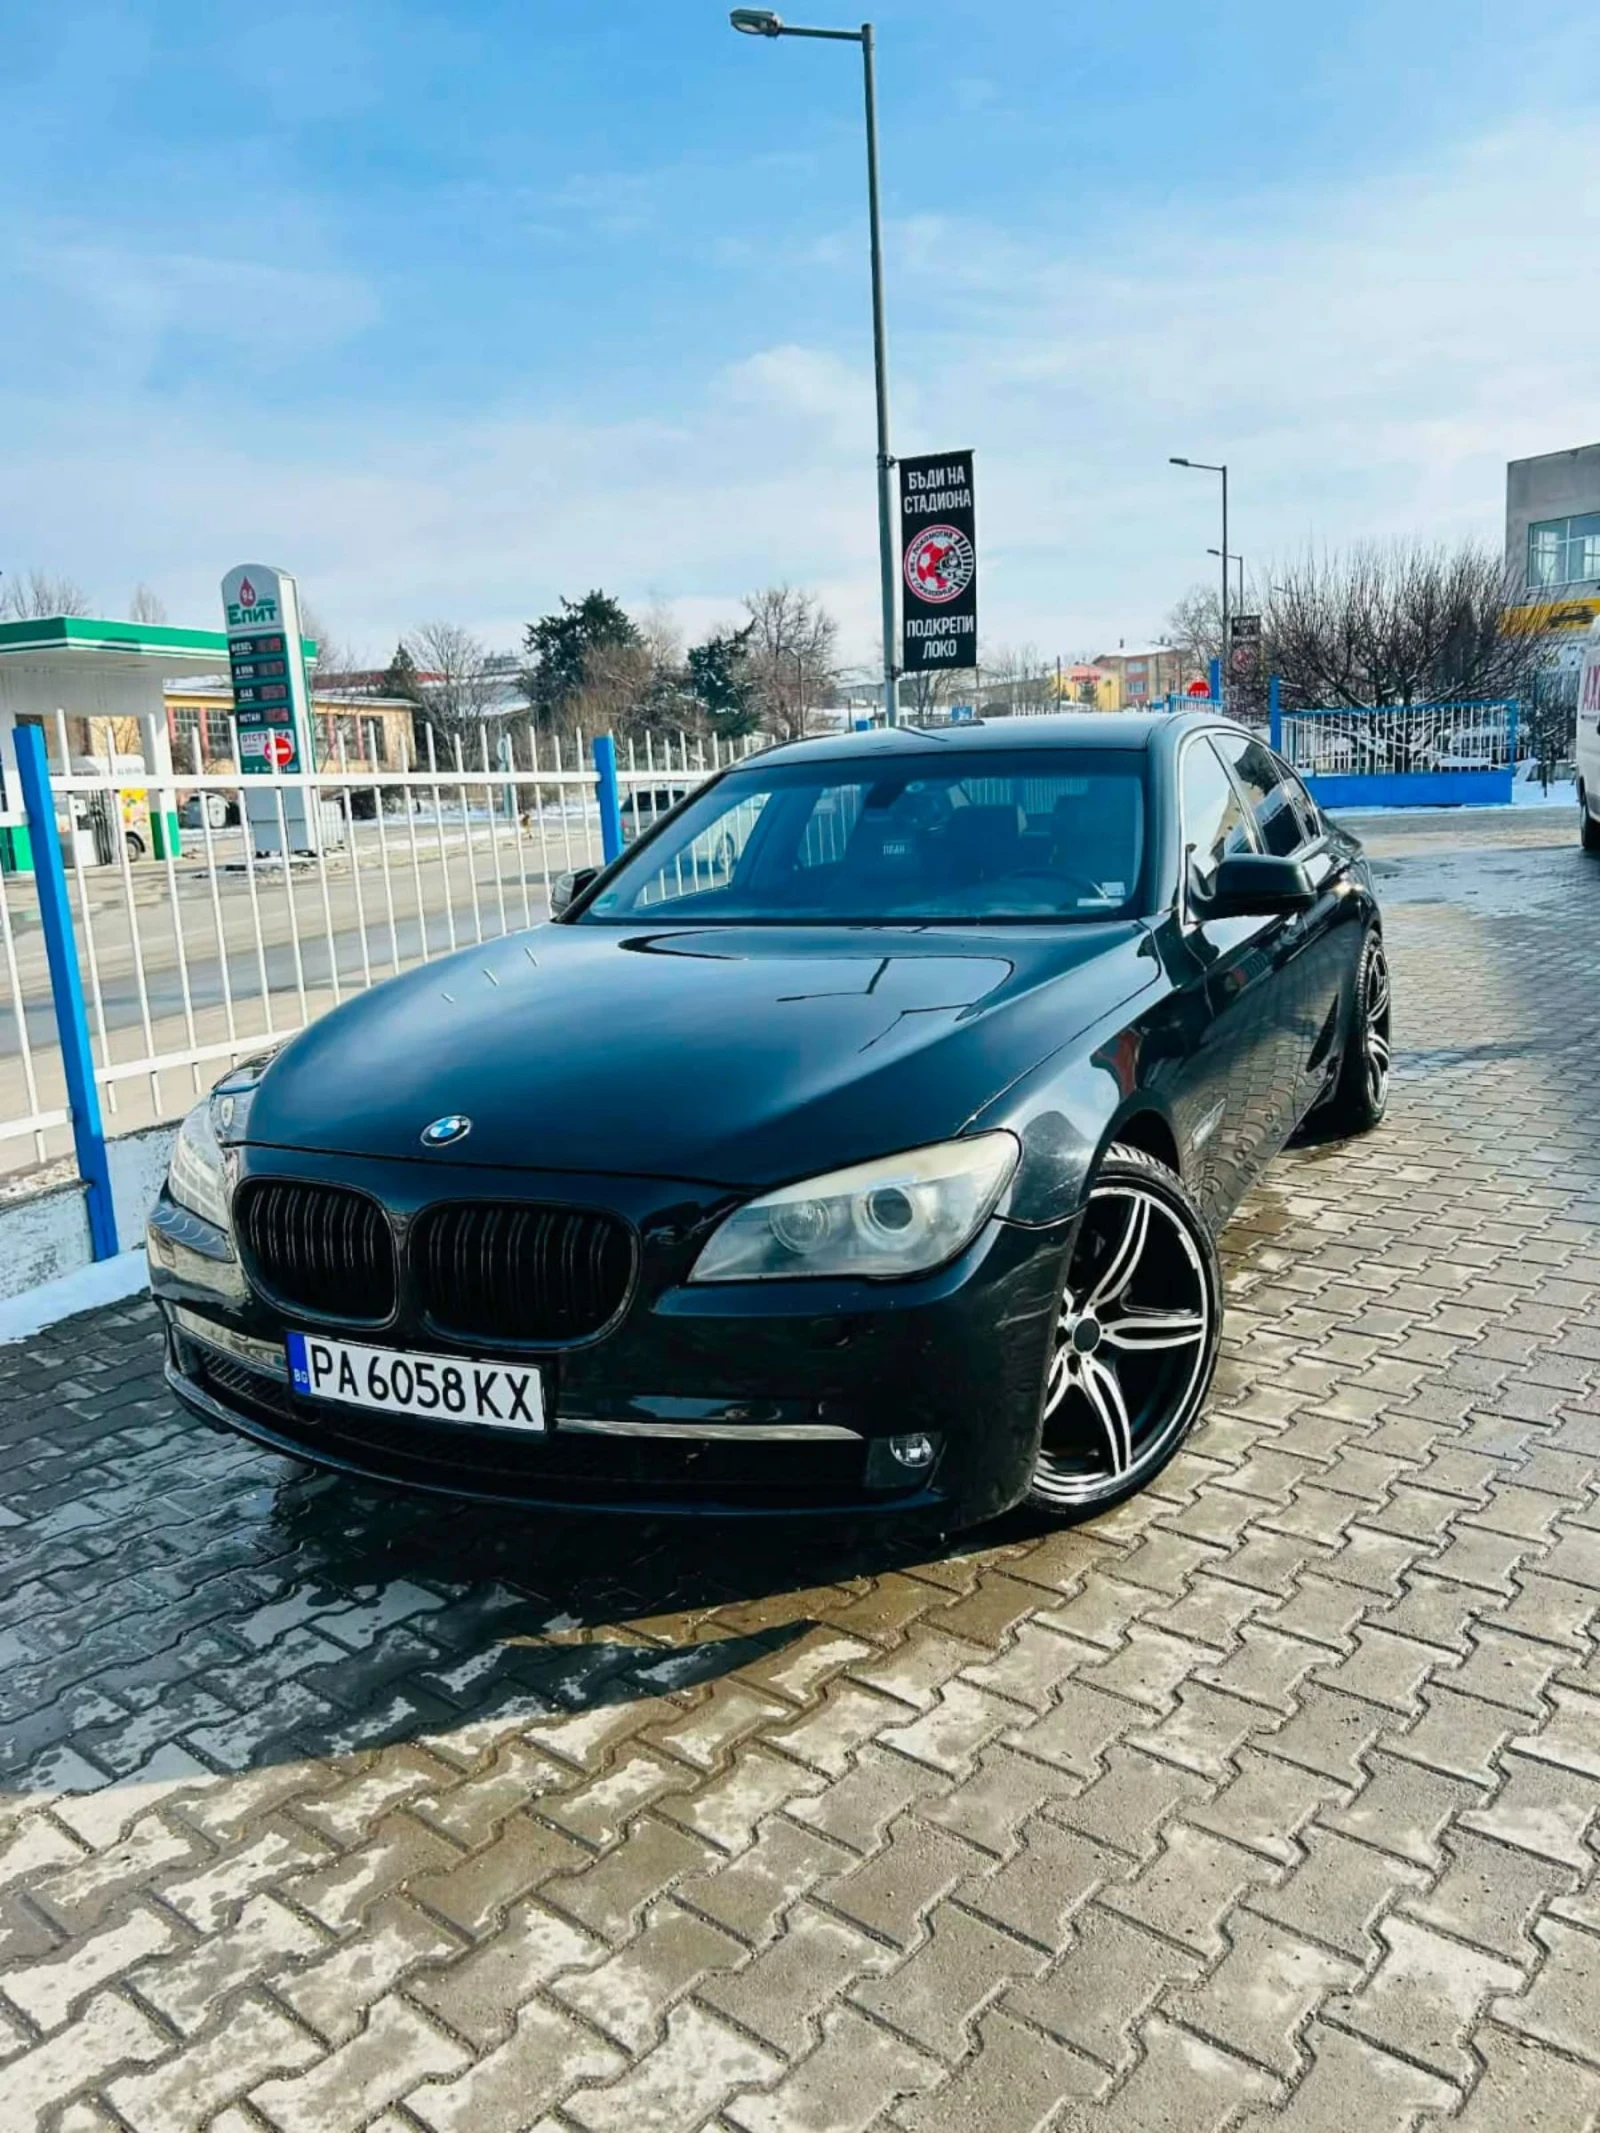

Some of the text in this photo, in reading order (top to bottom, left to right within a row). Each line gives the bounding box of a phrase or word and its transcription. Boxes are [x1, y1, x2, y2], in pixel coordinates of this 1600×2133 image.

[908, 465, 966, 490] БЪДИ НА
[903, 488, 972, 514] СТАДИОНА
[906, 615, 975, 638] ПОДКРЕПИ
[922, 639, 957, 659] ЛОКО
[293, 1367, 308, 1384] BG
